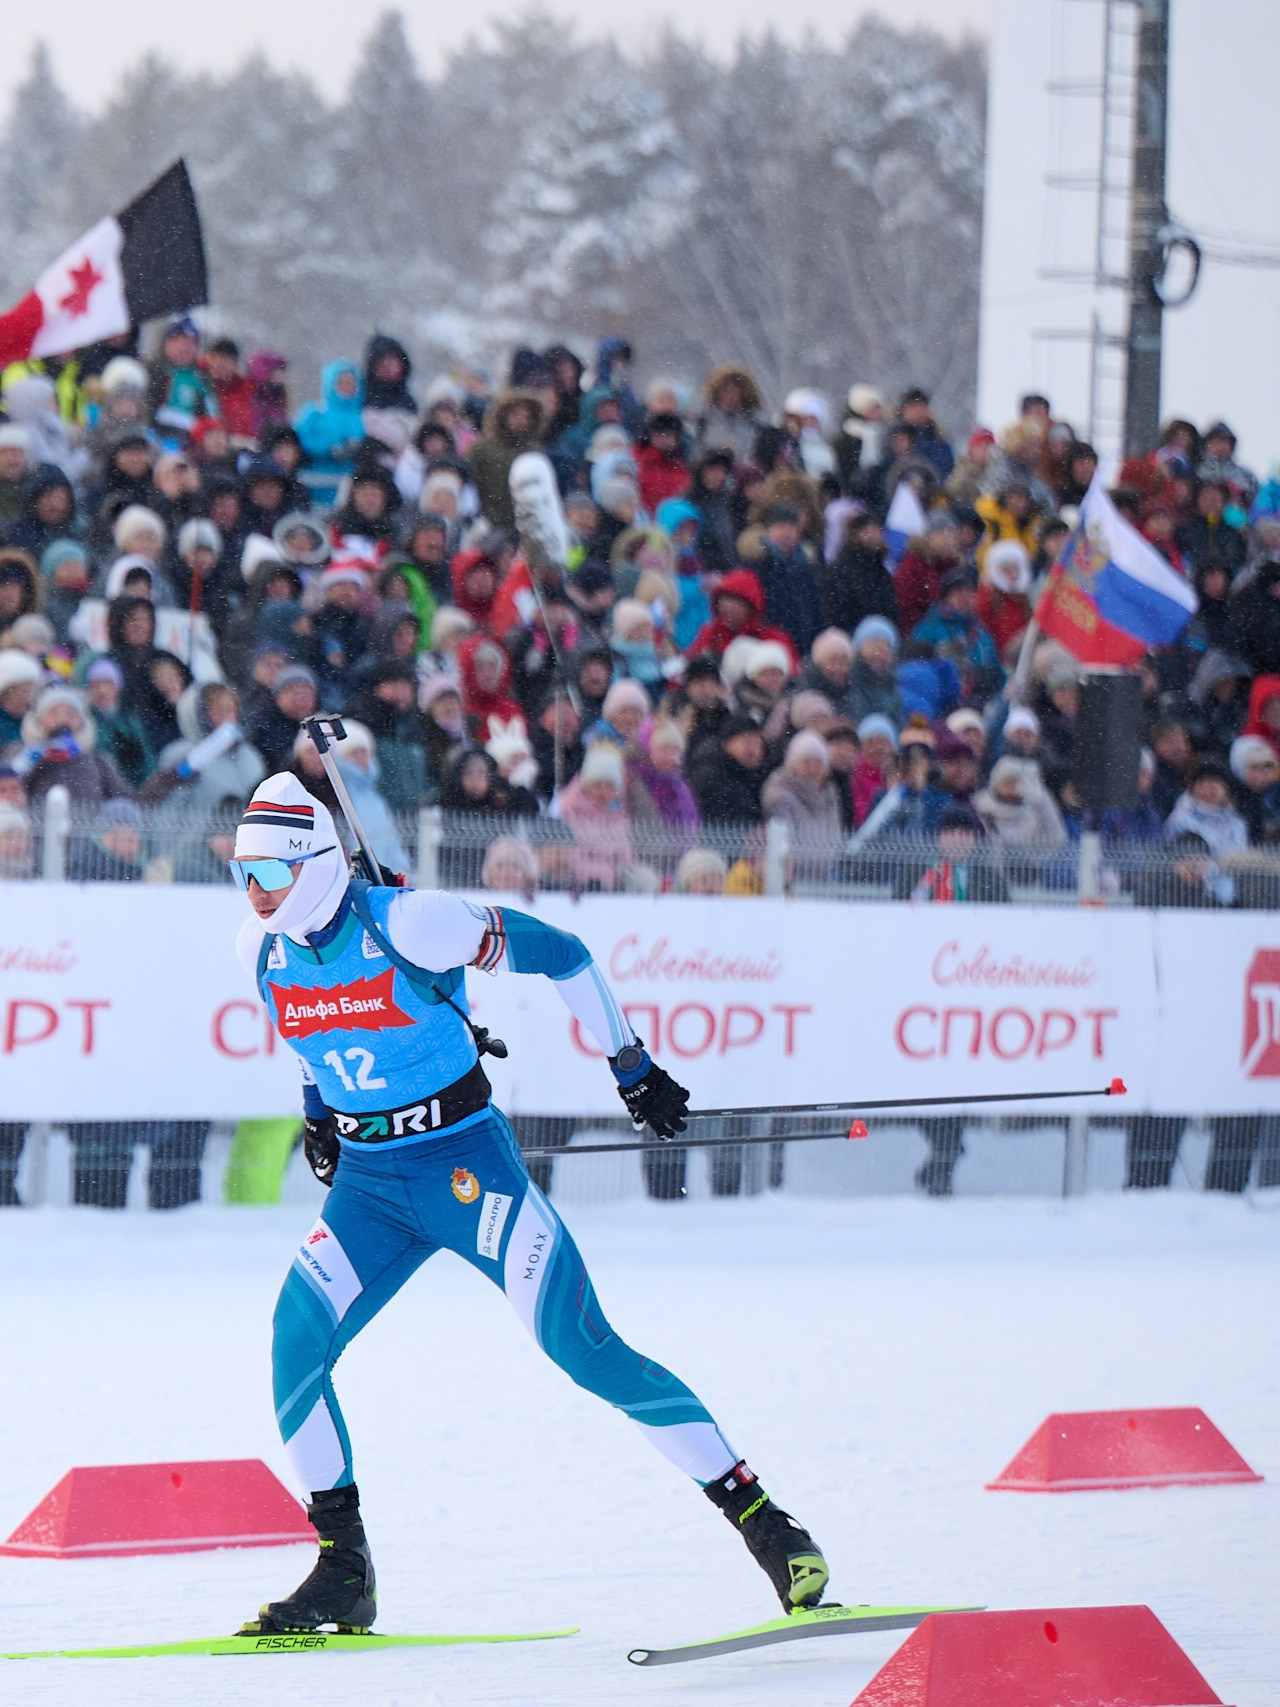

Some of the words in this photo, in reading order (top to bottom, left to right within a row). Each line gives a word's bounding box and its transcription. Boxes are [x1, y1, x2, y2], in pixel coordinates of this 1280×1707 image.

[609, 934, 783, 984] Советский
[932, 940, 1096, 988] Советский
[285, 999, 339, 1020] Альфа
[339, 997, 387, 1014] Банк
[894, 1006, 1118, 1061] СПОРТ
[322, 1047, 387, 1091] 12
[333, 1099, 441, 1139] PARI
[485, 1196, 502, 1243] ФОСАГРО
[524, 1232, 548, 1280] MOAX
[814, 1608, 854, 1619] FISCHER
[255, 1637, 327, 1649] FISCHER
